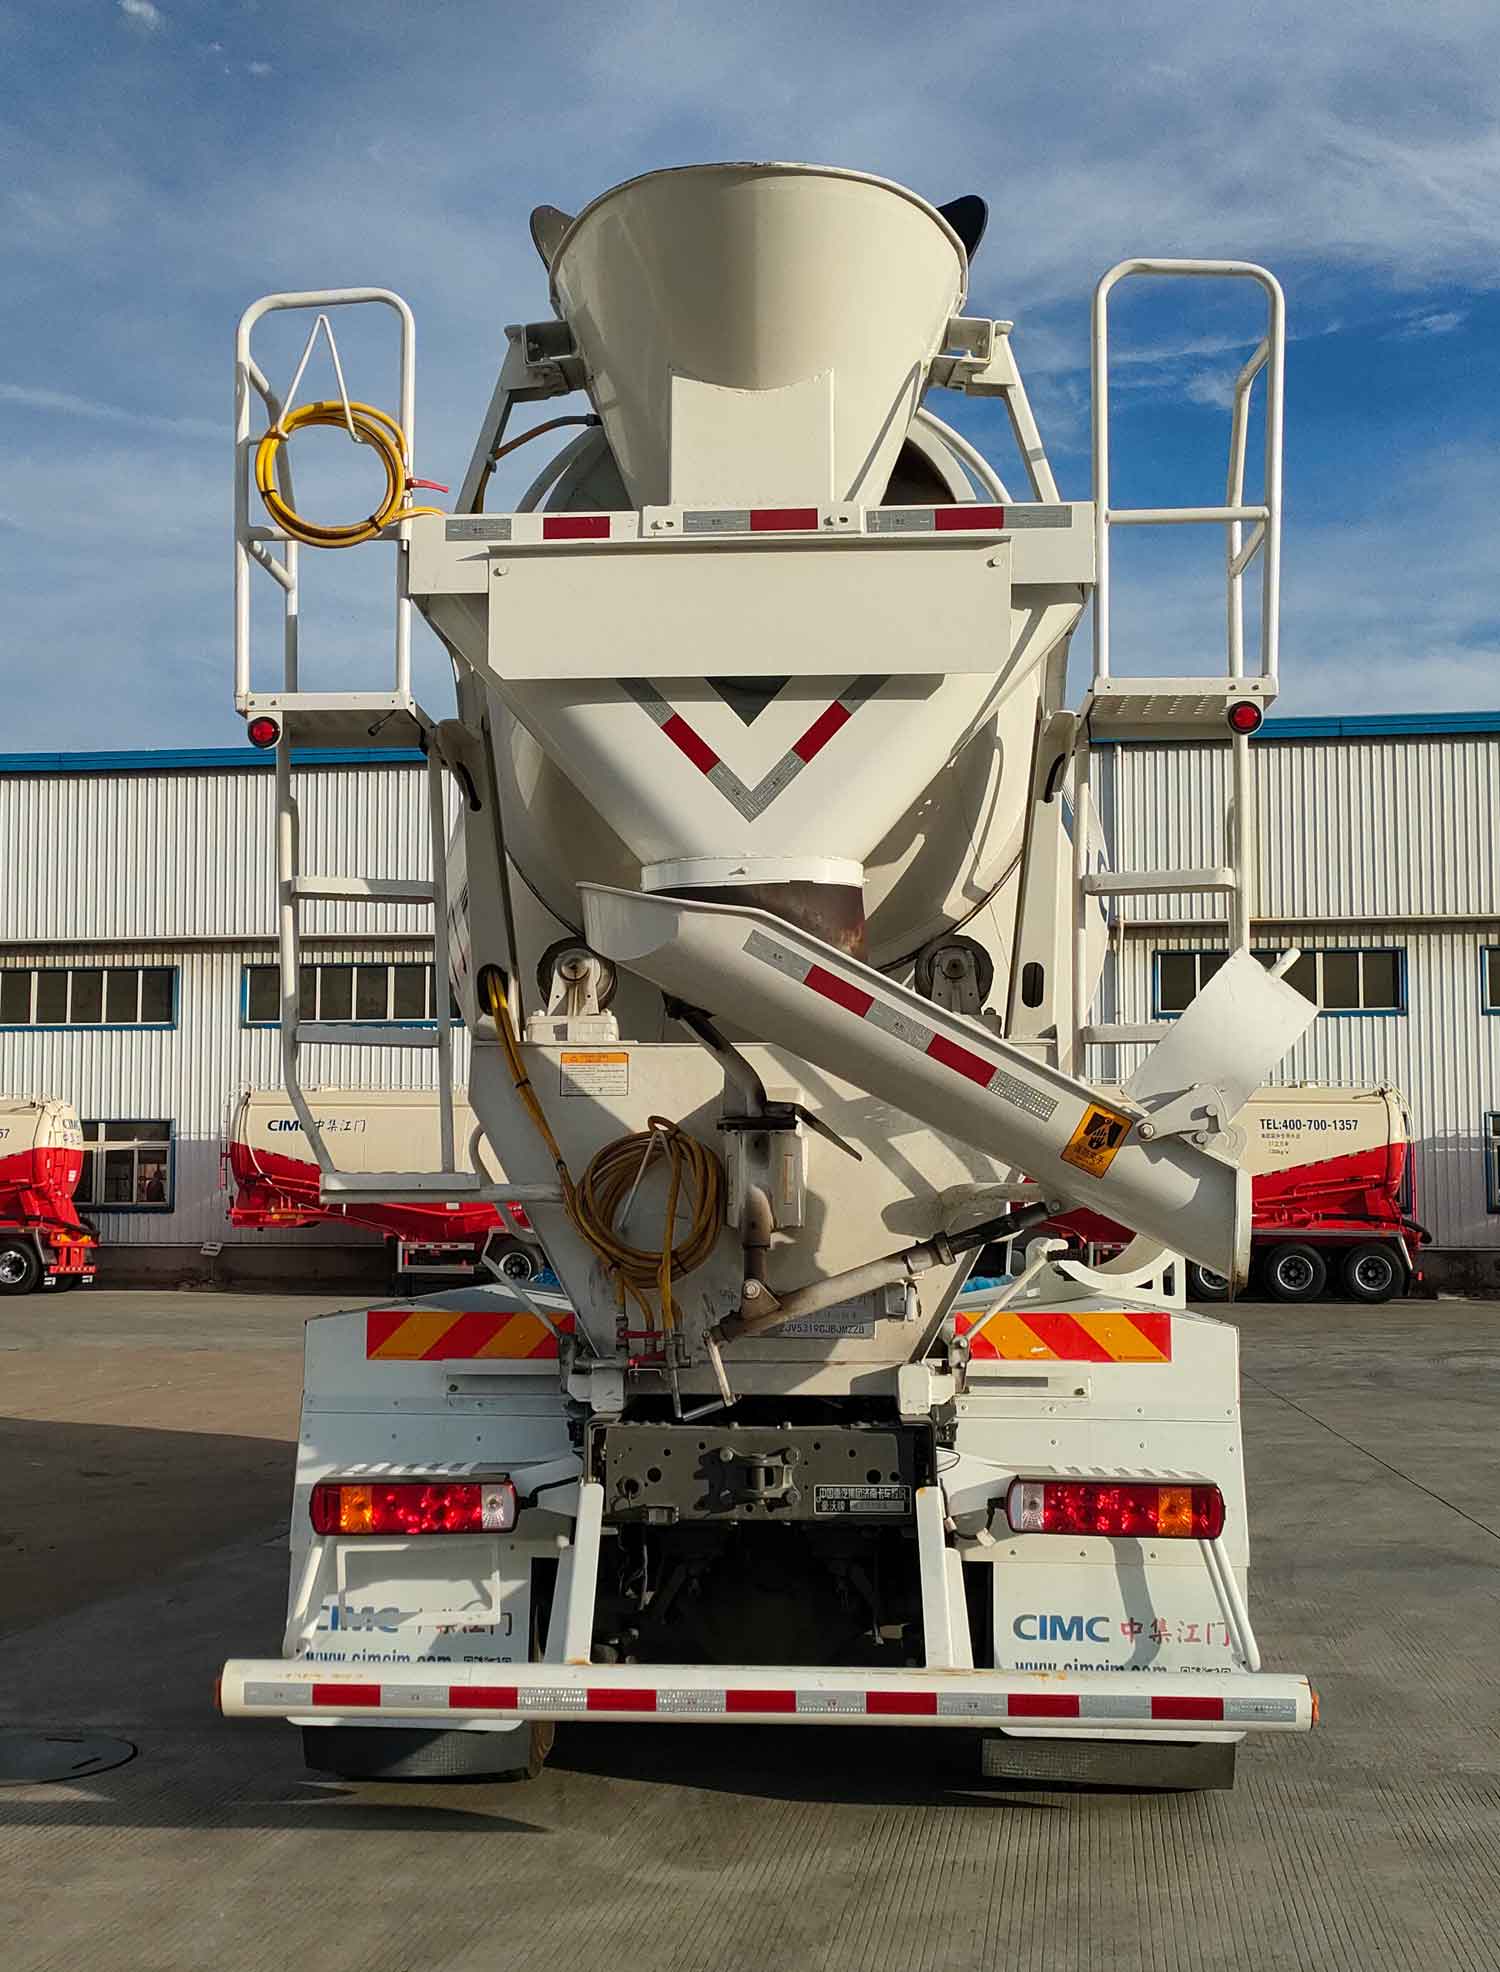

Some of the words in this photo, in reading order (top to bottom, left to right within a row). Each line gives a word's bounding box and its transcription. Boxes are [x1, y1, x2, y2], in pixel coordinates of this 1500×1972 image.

[1259, 1118, 1358, 1131] TEL:400-700-1357
[1012, 1613, 1110, 1643] CIMC
[1120, 1615, 1231, 1648] 中集江门
